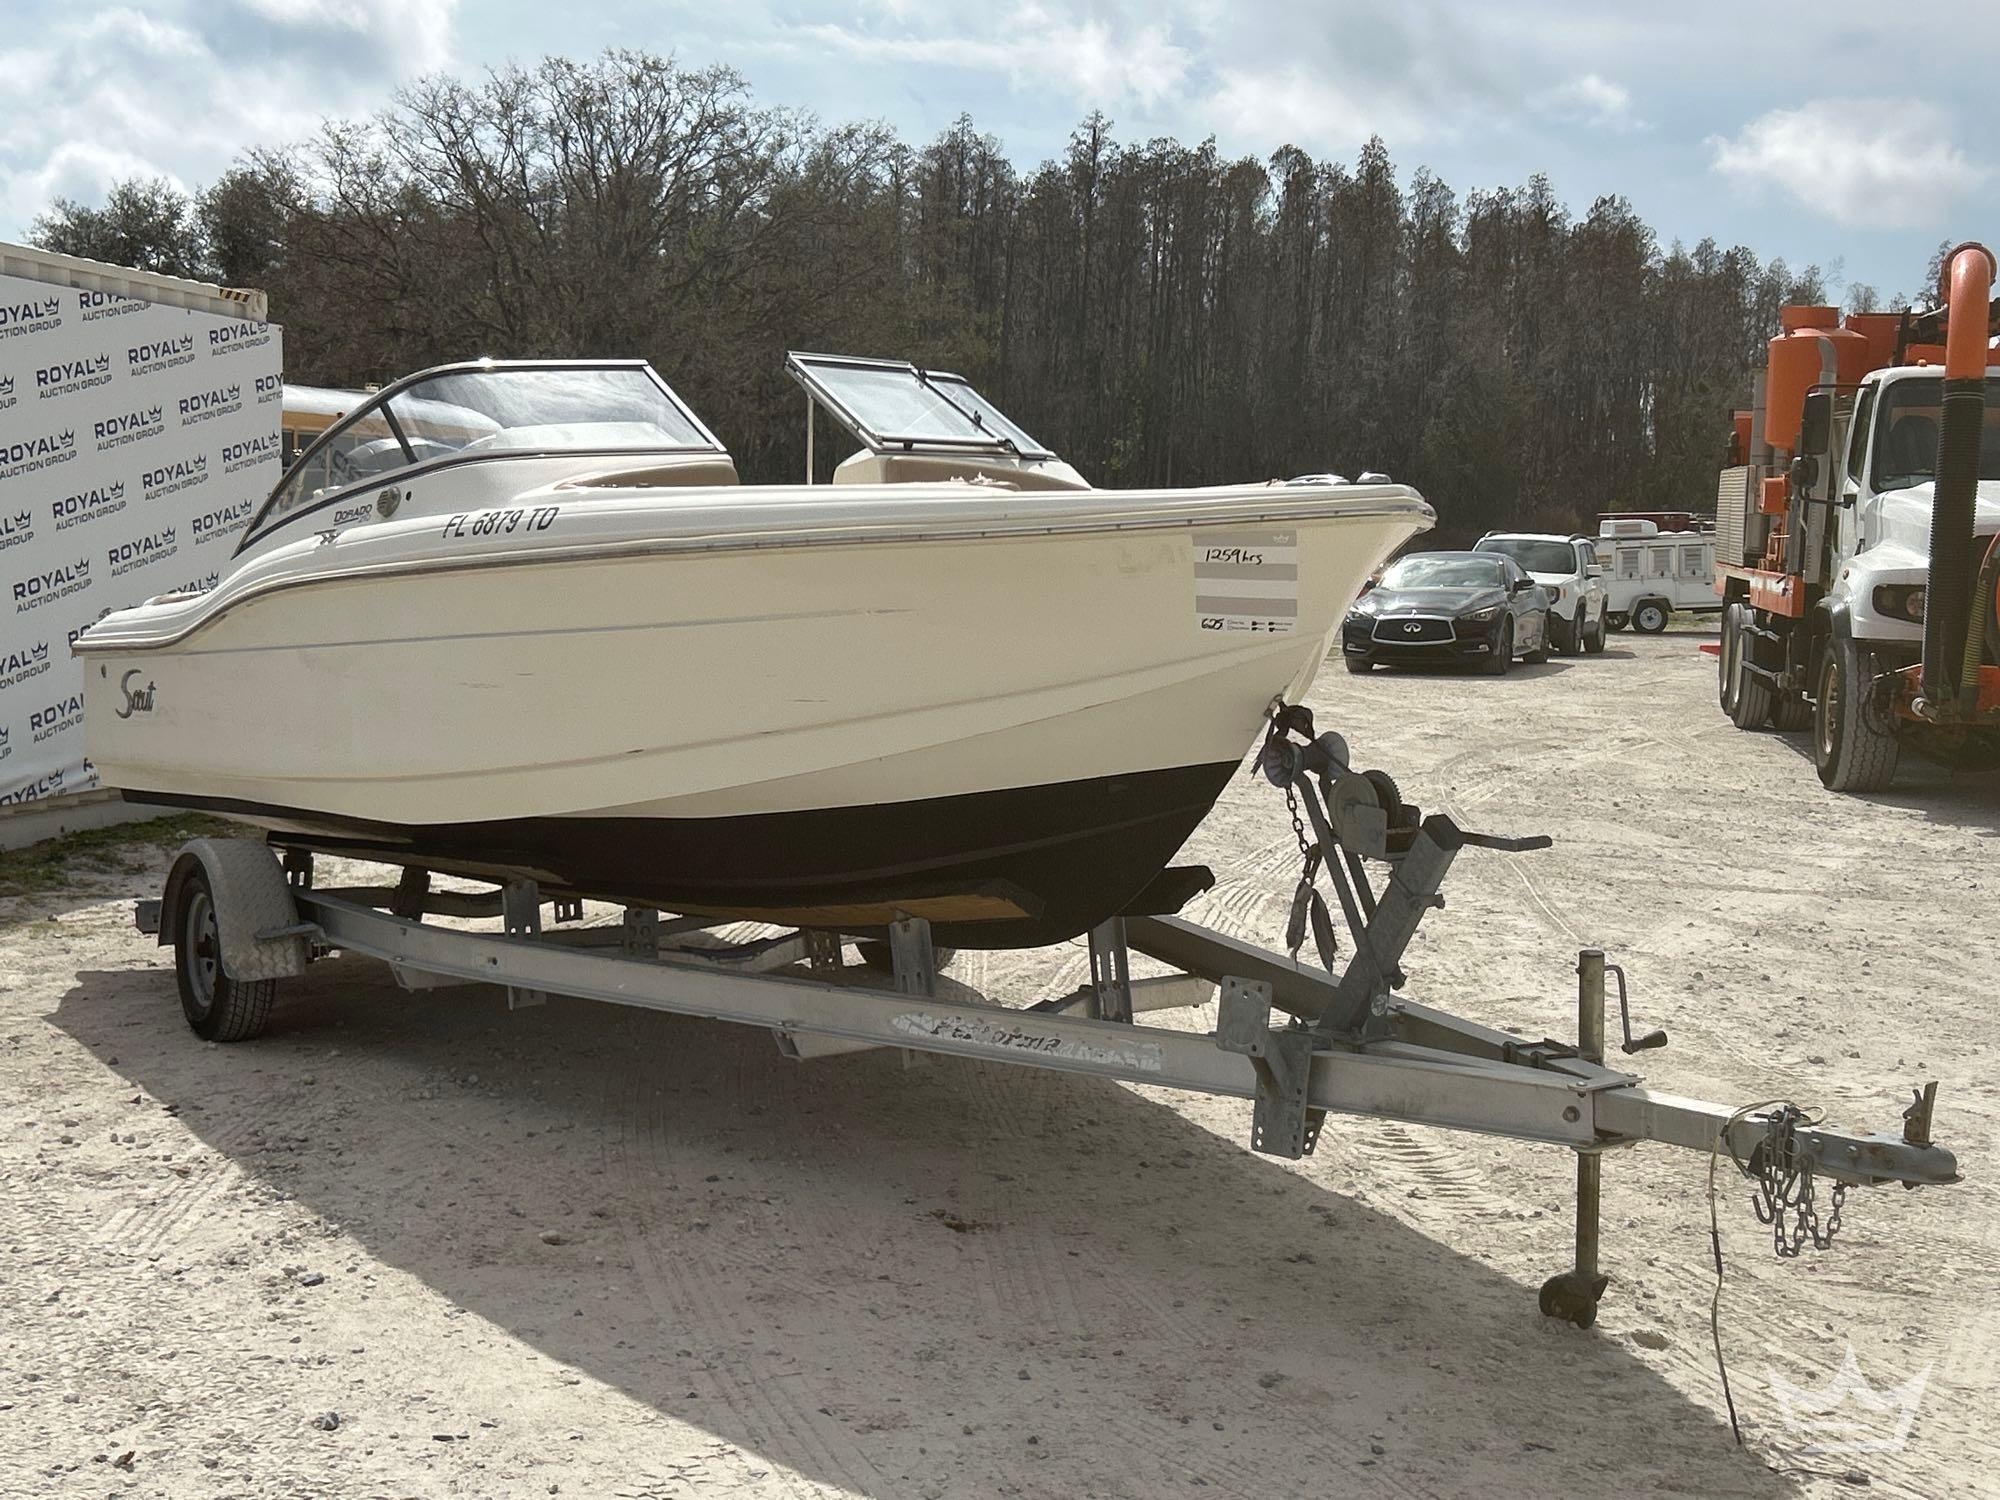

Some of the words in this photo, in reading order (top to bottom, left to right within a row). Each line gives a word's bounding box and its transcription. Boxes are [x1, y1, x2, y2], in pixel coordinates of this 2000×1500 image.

[0, 302, 44, 325] OYAL
[79, 291, 127, 309] ROY
[29, 318, 62, 334] GROUP
[82, 308, 120, 322] AUCTION
[209, 322, 257, 345] ROYAL
[212, 343, 244, 357] AUCTION
[245, 335, 270, 348] GROUP
[128, 339, 180, 364] ROYAL
[131, 360, 166, 377] AUCTION
[167, 353, 195, 368] GROUP
[36, 359, 96, 387] ROYAL
[255, 373, 283, 393] ROY
[39, 382, 80, 400] AUCTION
[81, 374, 112, 390] GROUP
[178, 389, 229, 415] ROYAL
[181, 409, 216, 426] AUCTION
[217, 402, 242, 417] GROUP
[94, 411, 149, 439] ROYAL
[97, 434, 135, 452] AUCTION
[135, 424, 165, 441] GROUP
[0, 435, 60, 466] ROYAL
[222, 436, 269, 463] ROYAL
[0, 459, 44, 480] AUCTION
[45, 450, 77, 467] GROUP
[142, 460, 194, 490] ROYAL
[224, 456, 257, 474] AUCTION
[144, 483, 181, 501] AUCTION
[181, 473, 209, 489] GROUP
[52, 487, 110, 519] ROYAL
[56, 511, 95, 532] AUCTION
[96, 501, 127, 518] GROUP
[333, 504, 373, 523] DORADO
[192, 505, 241, 534] ROYAL
[442, 514, 469, 539] FL
[472, 509, 525, 536] 6879
[195, 526, 228, 546] AUCTION
[108, 534, 163, 566] ROYAL
[111, 556, 149, 578] AUCTION
[149, 545, 178, 563] GROUP
[13, 566, 76, 601] ROYAL
[16, 590, 60, 614] AUCTION
[61, 577, 92, 597] GROUP
[16, 661, 51, 683] GROUP
[33, 717, 75, 744] AUCTION
